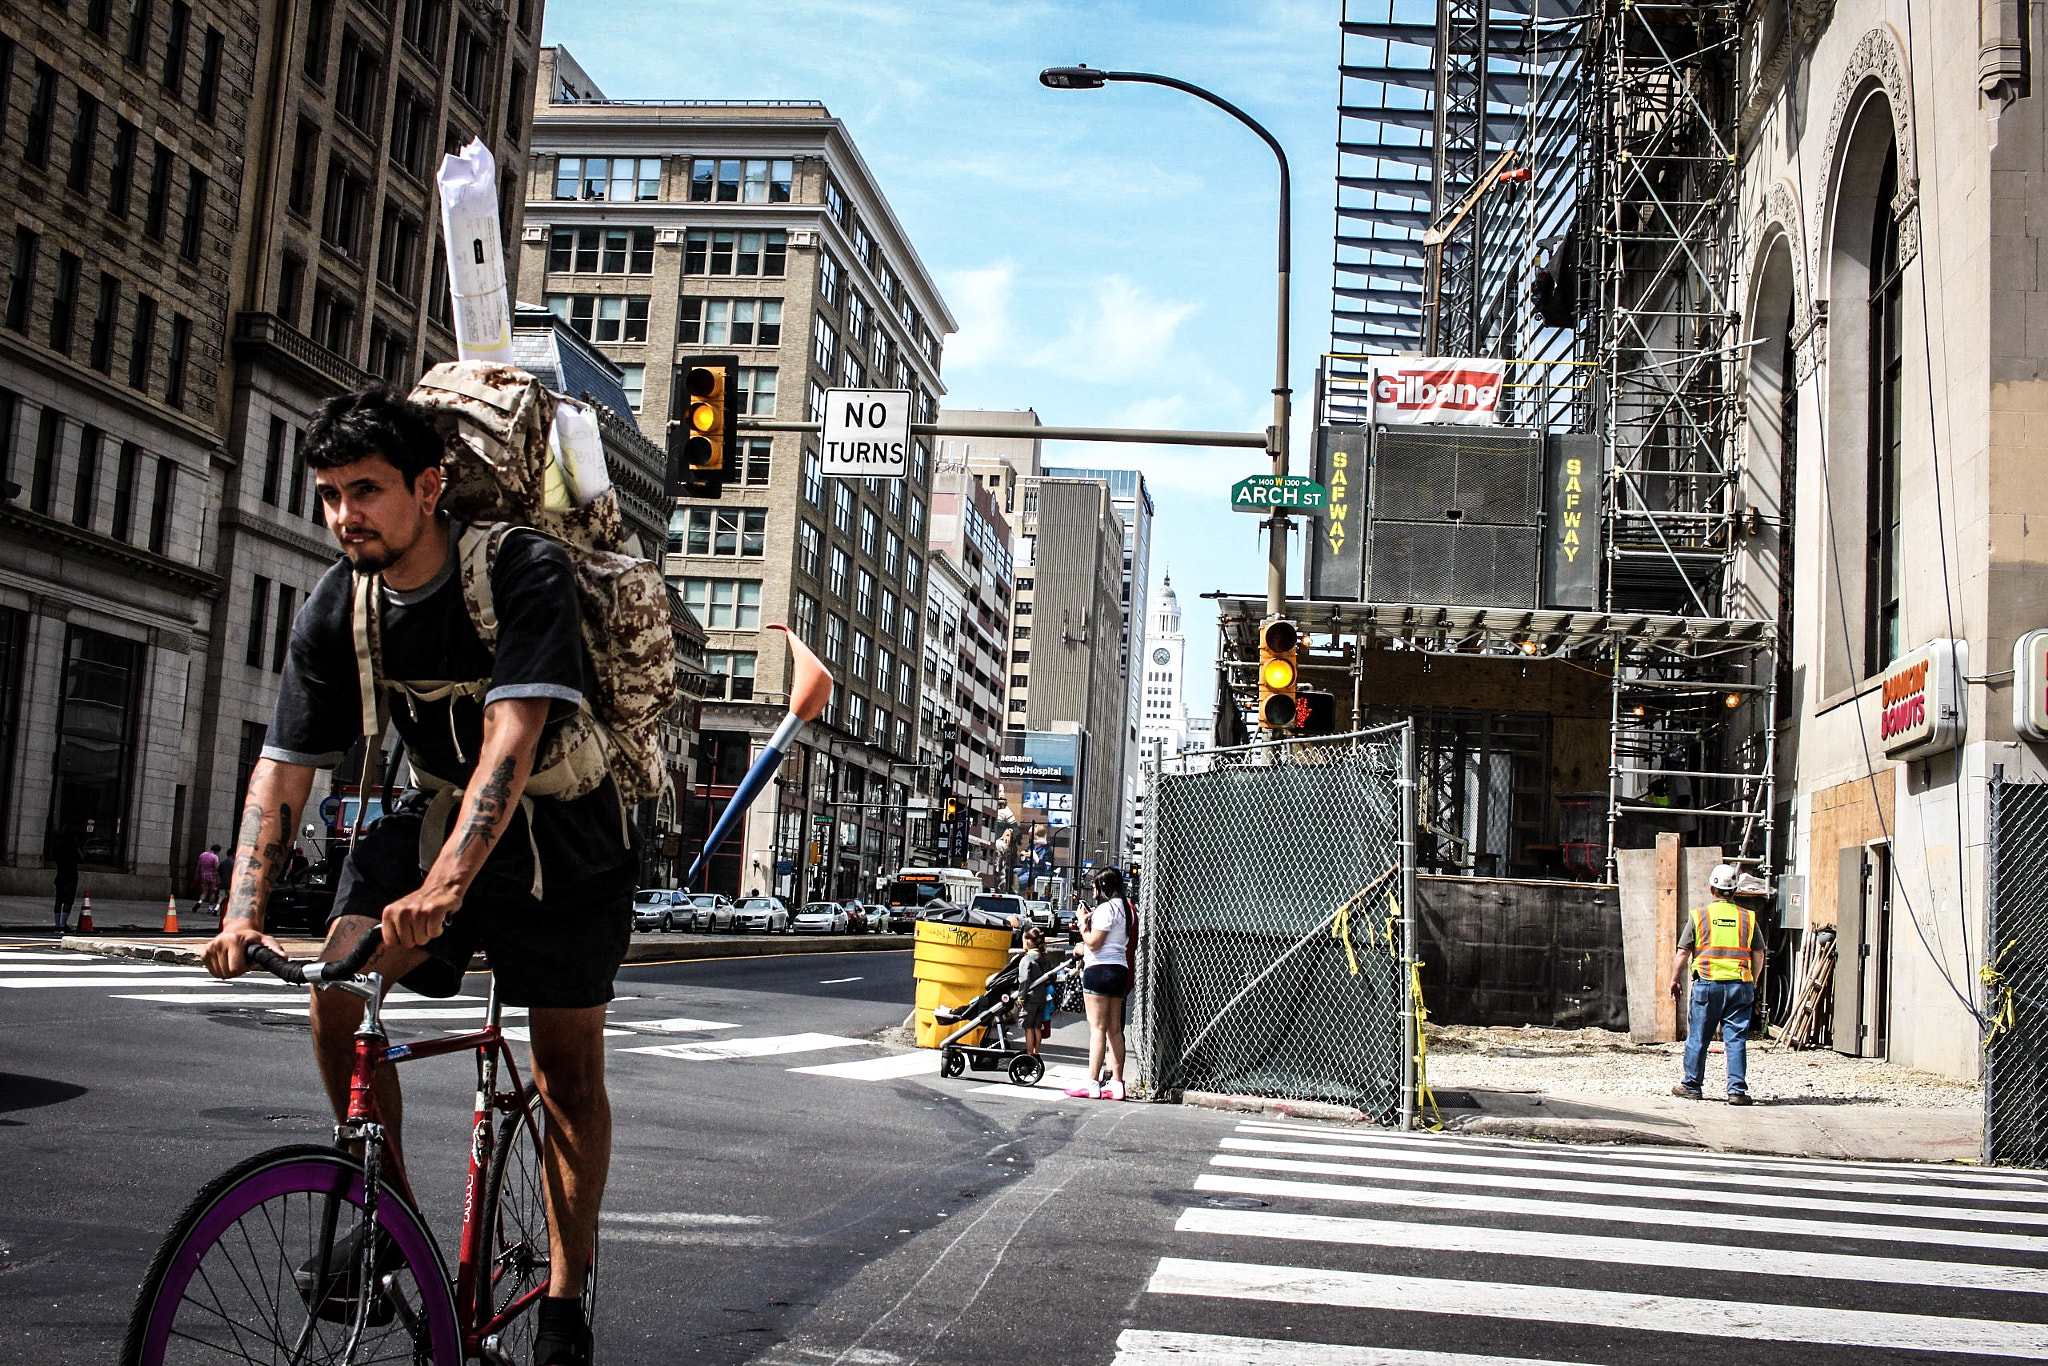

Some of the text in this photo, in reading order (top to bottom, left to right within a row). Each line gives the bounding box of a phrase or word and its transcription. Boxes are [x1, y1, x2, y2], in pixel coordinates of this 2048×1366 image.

[1371, 375, 1498, 407] Gilbane
[845, 402, 887, 429] NO
[826, 441, 904, 465] TURNS
[1236, 485, 1322, 506] ARCH ST
[1258, 477, 1300, 487] 1400 W 1300
[1329, 451, 1348, 555] SAFWAY
[1563, 458, 1582, 563] SAFWAY
[1881, 694, 1926, 741] DONUTS
[1026, 766, 1062, 777] Hospital
[955, 821, 965, 856] PARK
